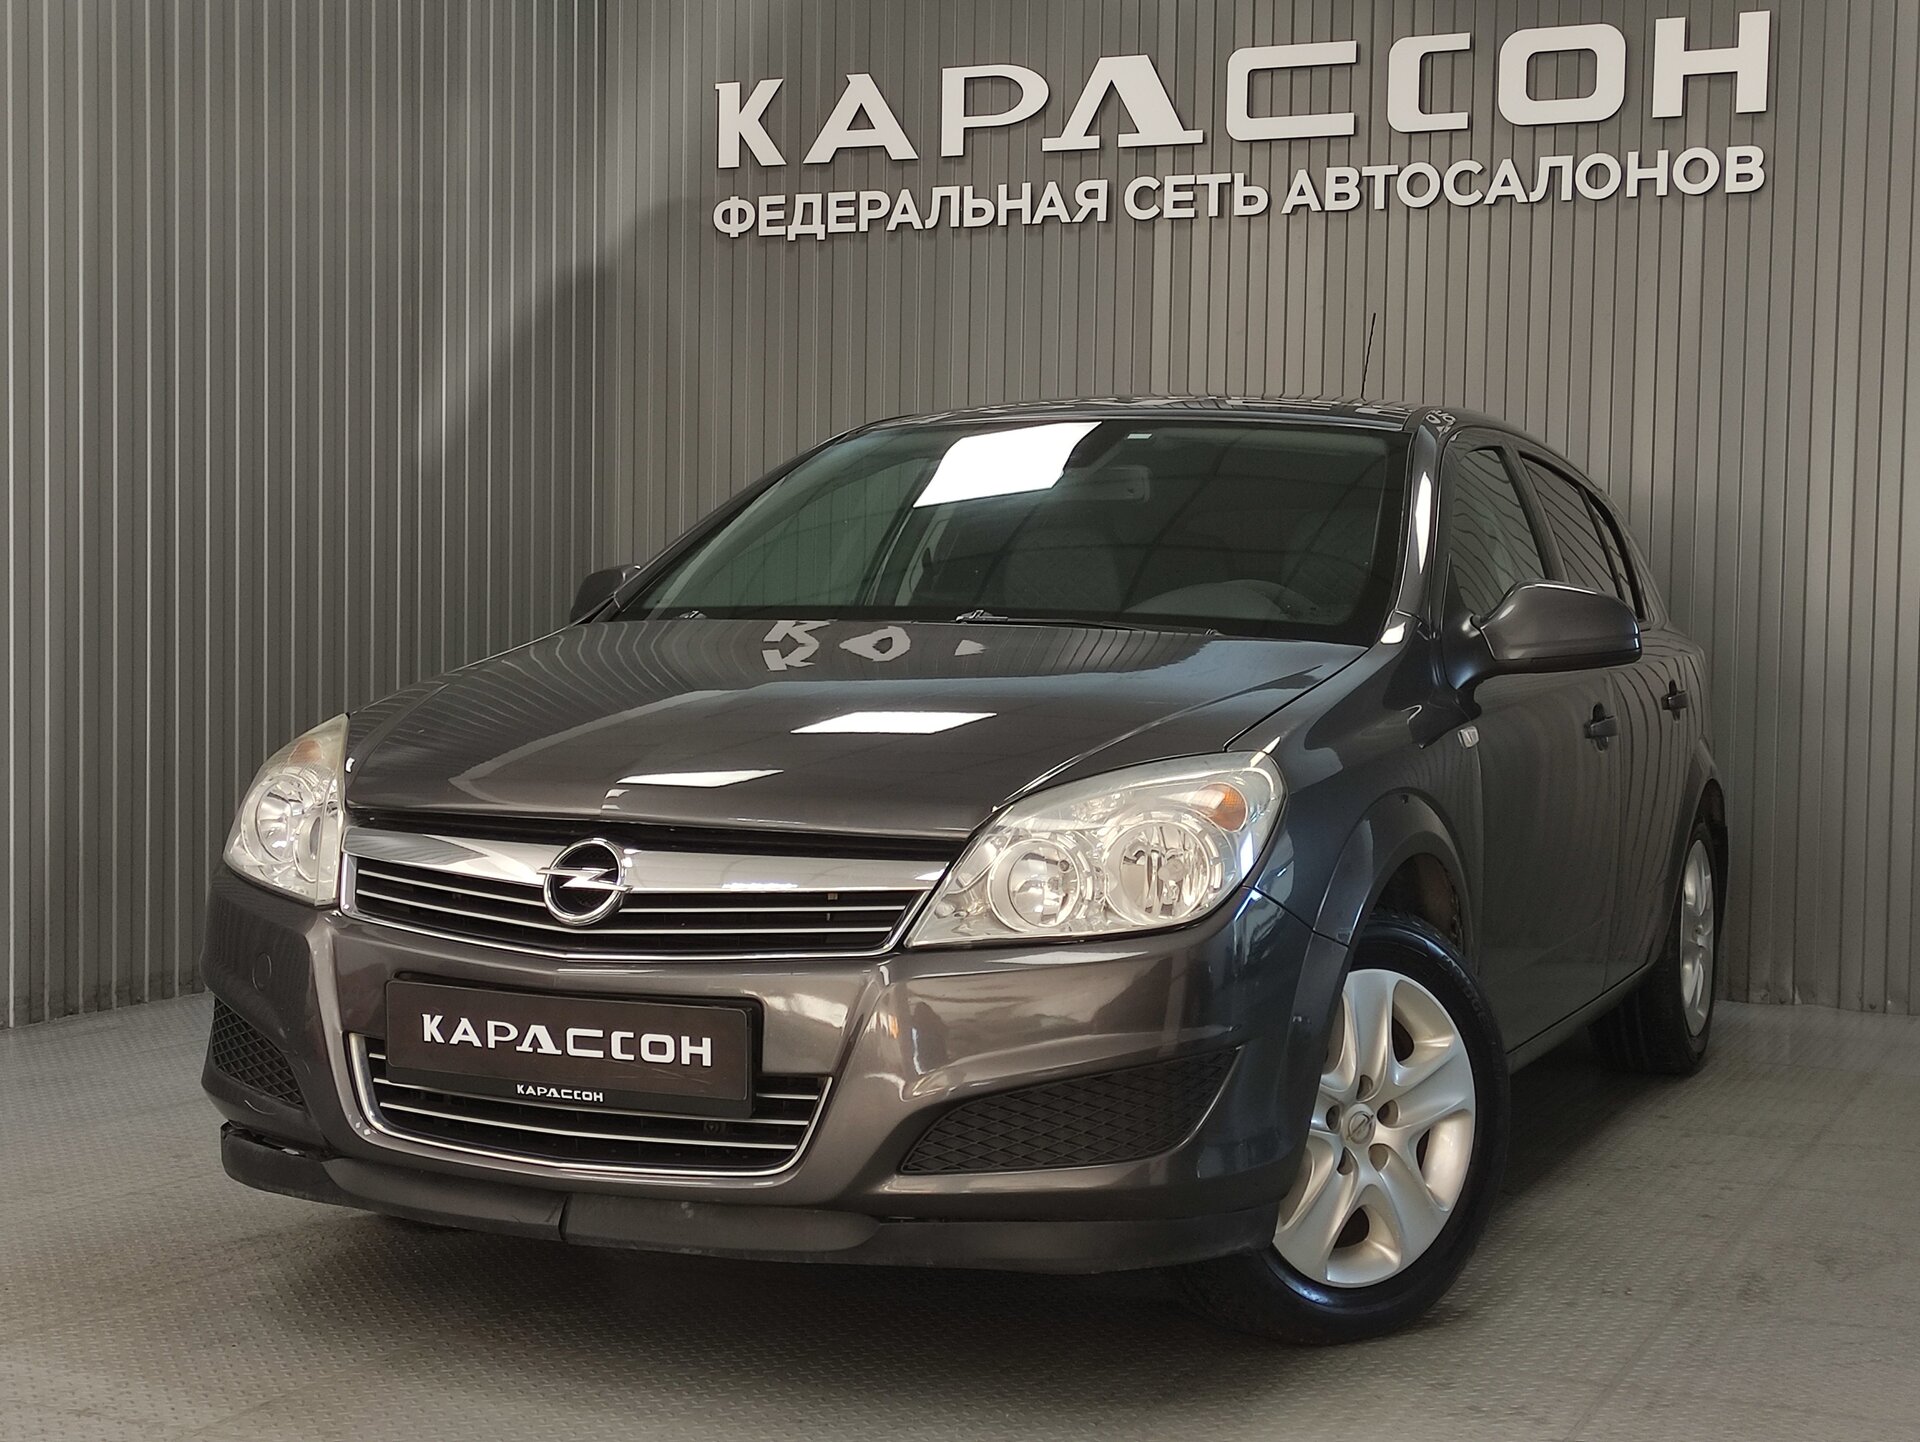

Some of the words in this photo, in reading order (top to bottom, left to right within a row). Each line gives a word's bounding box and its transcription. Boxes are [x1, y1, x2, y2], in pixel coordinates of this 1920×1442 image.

[714, 180, 1108, 240] ФЕДЕРАЛЬНАЯ
[1125, 173, 1268, 219] СЕТЬ
[1282, 146, 1765, 213] АВТОСАЛОНОВ
